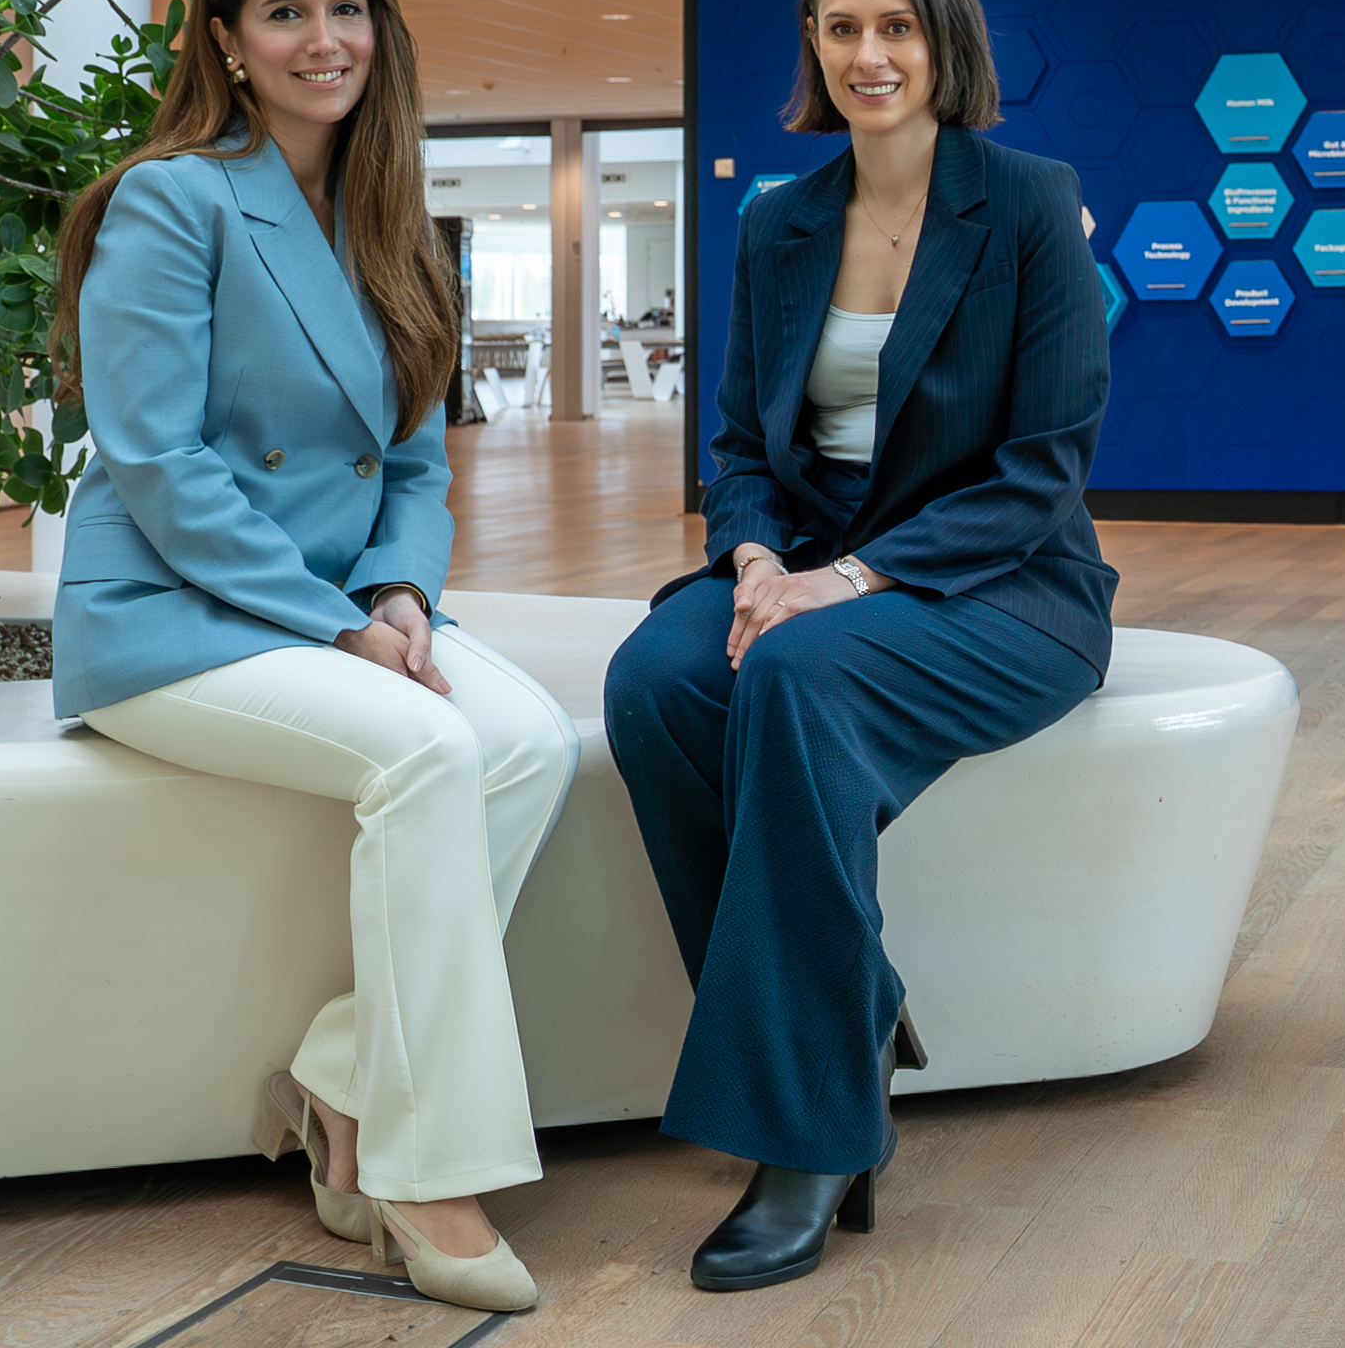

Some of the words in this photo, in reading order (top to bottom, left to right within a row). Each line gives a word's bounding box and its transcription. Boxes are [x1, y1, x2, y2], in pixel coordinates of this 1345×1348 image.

[1225, 99, 1256, 108] Human
[1256, 98, 1275, 107] Milk
[1322, 140, 1340, 150] Gut
[1232, 196, 1277, 205] Functional
[1227, 205, 1275, 215] Ingredients
[1151, 242, 1184, 251] Process
[1144, 251, 1191, 260] Technology
[1235, 289, 1269, 298] Product
[1224, 297, 1280, 307] Development
